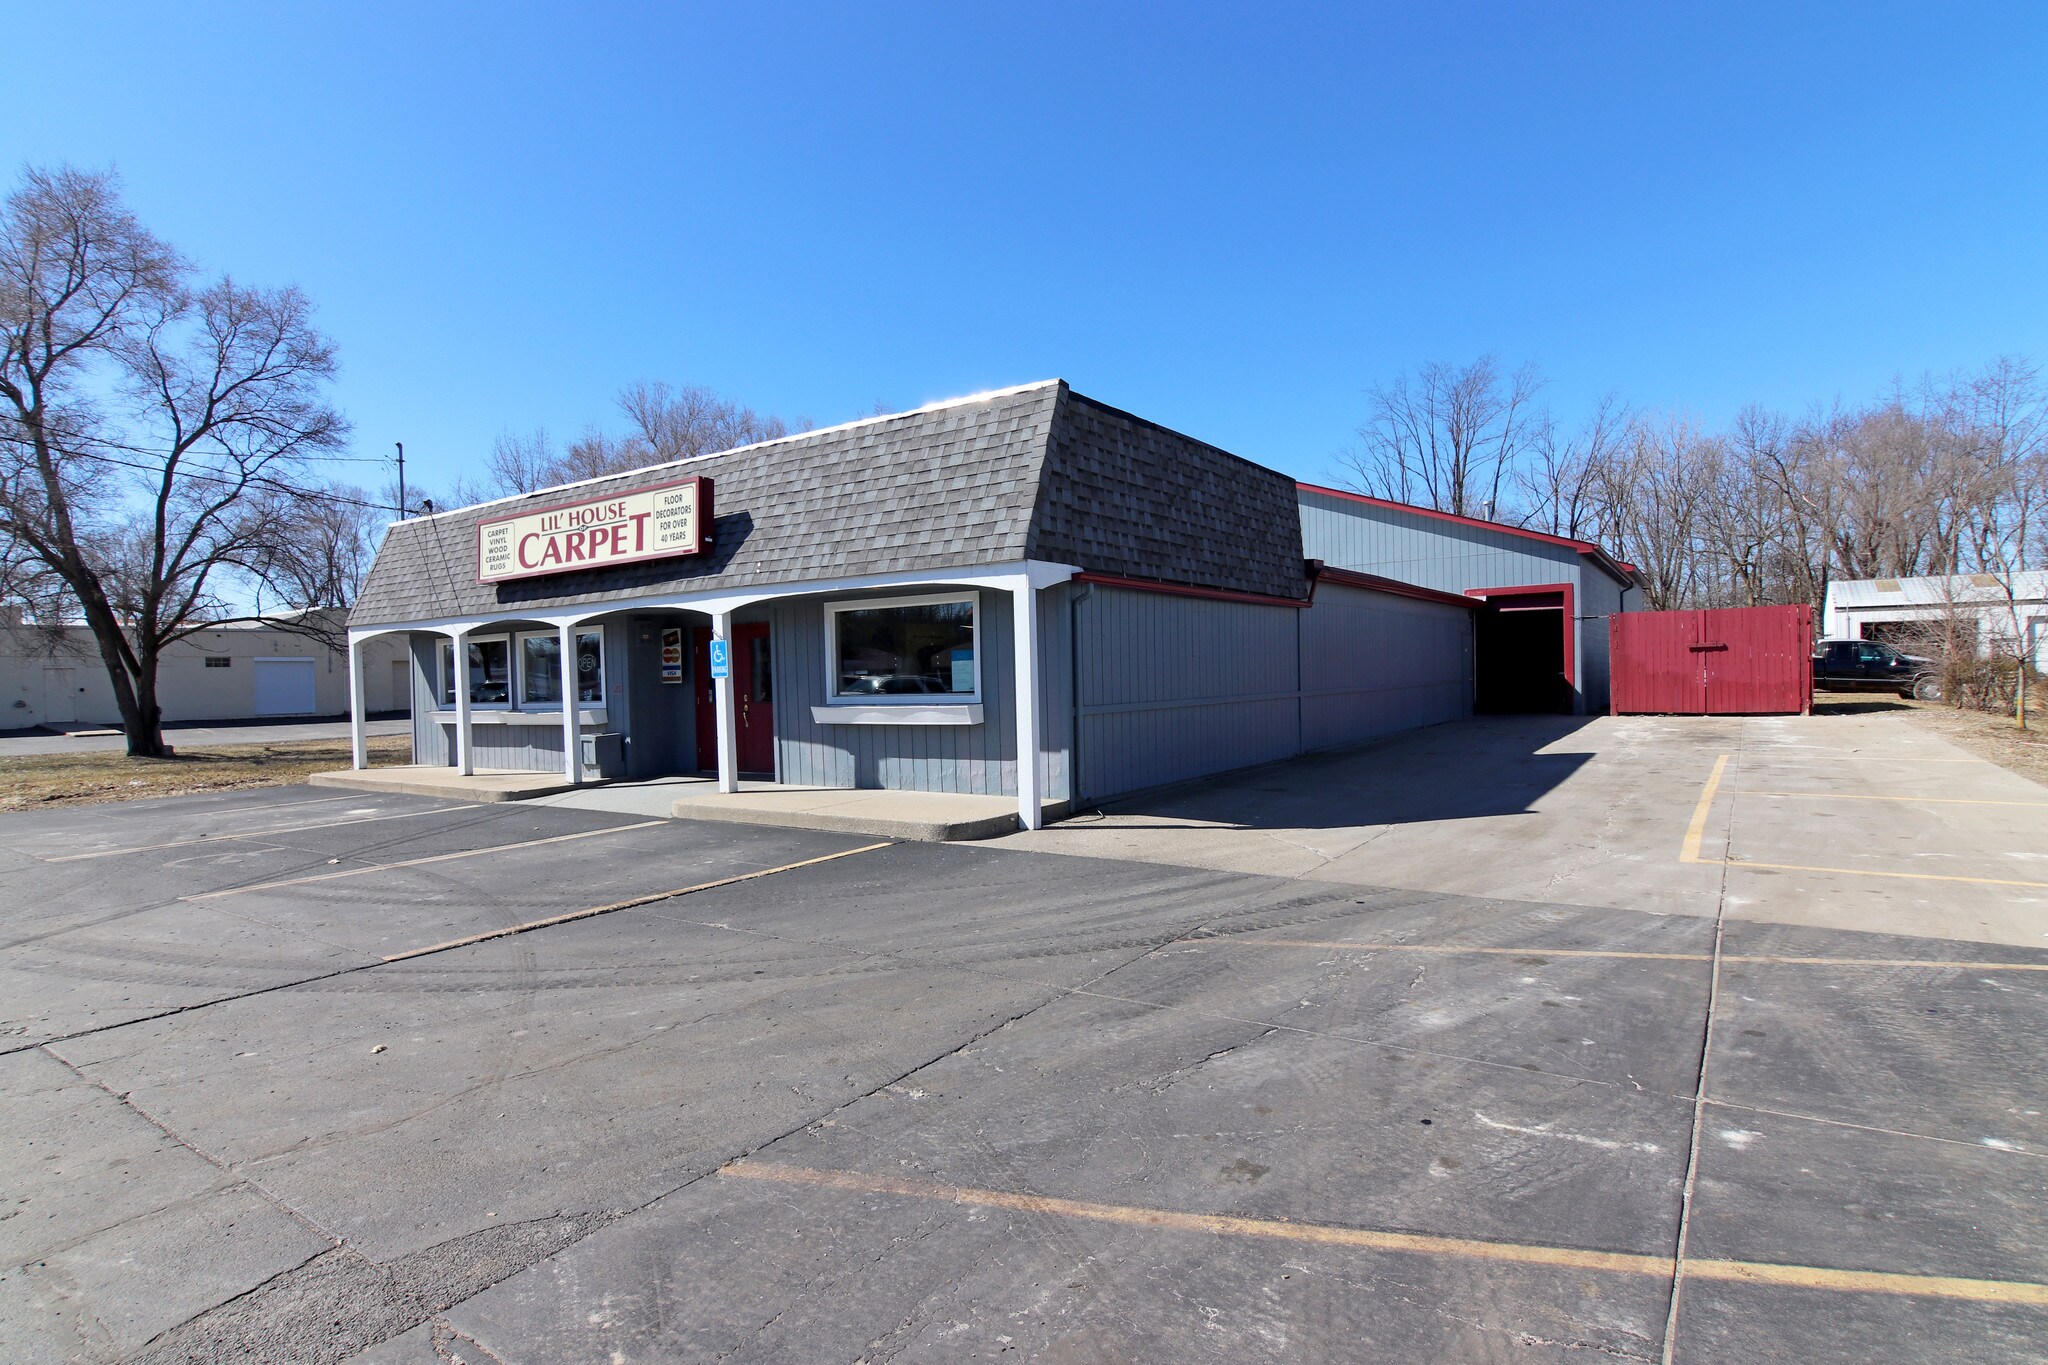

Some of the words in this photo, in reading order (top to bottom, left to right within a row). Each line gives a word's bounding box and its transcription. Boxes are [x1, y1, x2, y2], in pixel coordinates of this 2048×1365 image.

[664, 494, 683, 505] FLOOR
[569, 502, 626, 527] HOUSE
[656, 505, 692, 519] DECORATORS
[660, 521, 672, 531] FOR
[672, 518, 688, 529] OVER
[487, 528, 508, 537] CARPET
[661, 534, 668, 543] 40
[669, 531, 686, 541] YEARS
[489, 537, 507, 545] VINYL
[518, 512, 651, 569] CARPET
[488, 546, 507, 554] WOOD
[485, 553, 510, 563] CERAMIC
[490, 562, 506, 571] RUGS
[578, 657, 597, 668] OPEN
